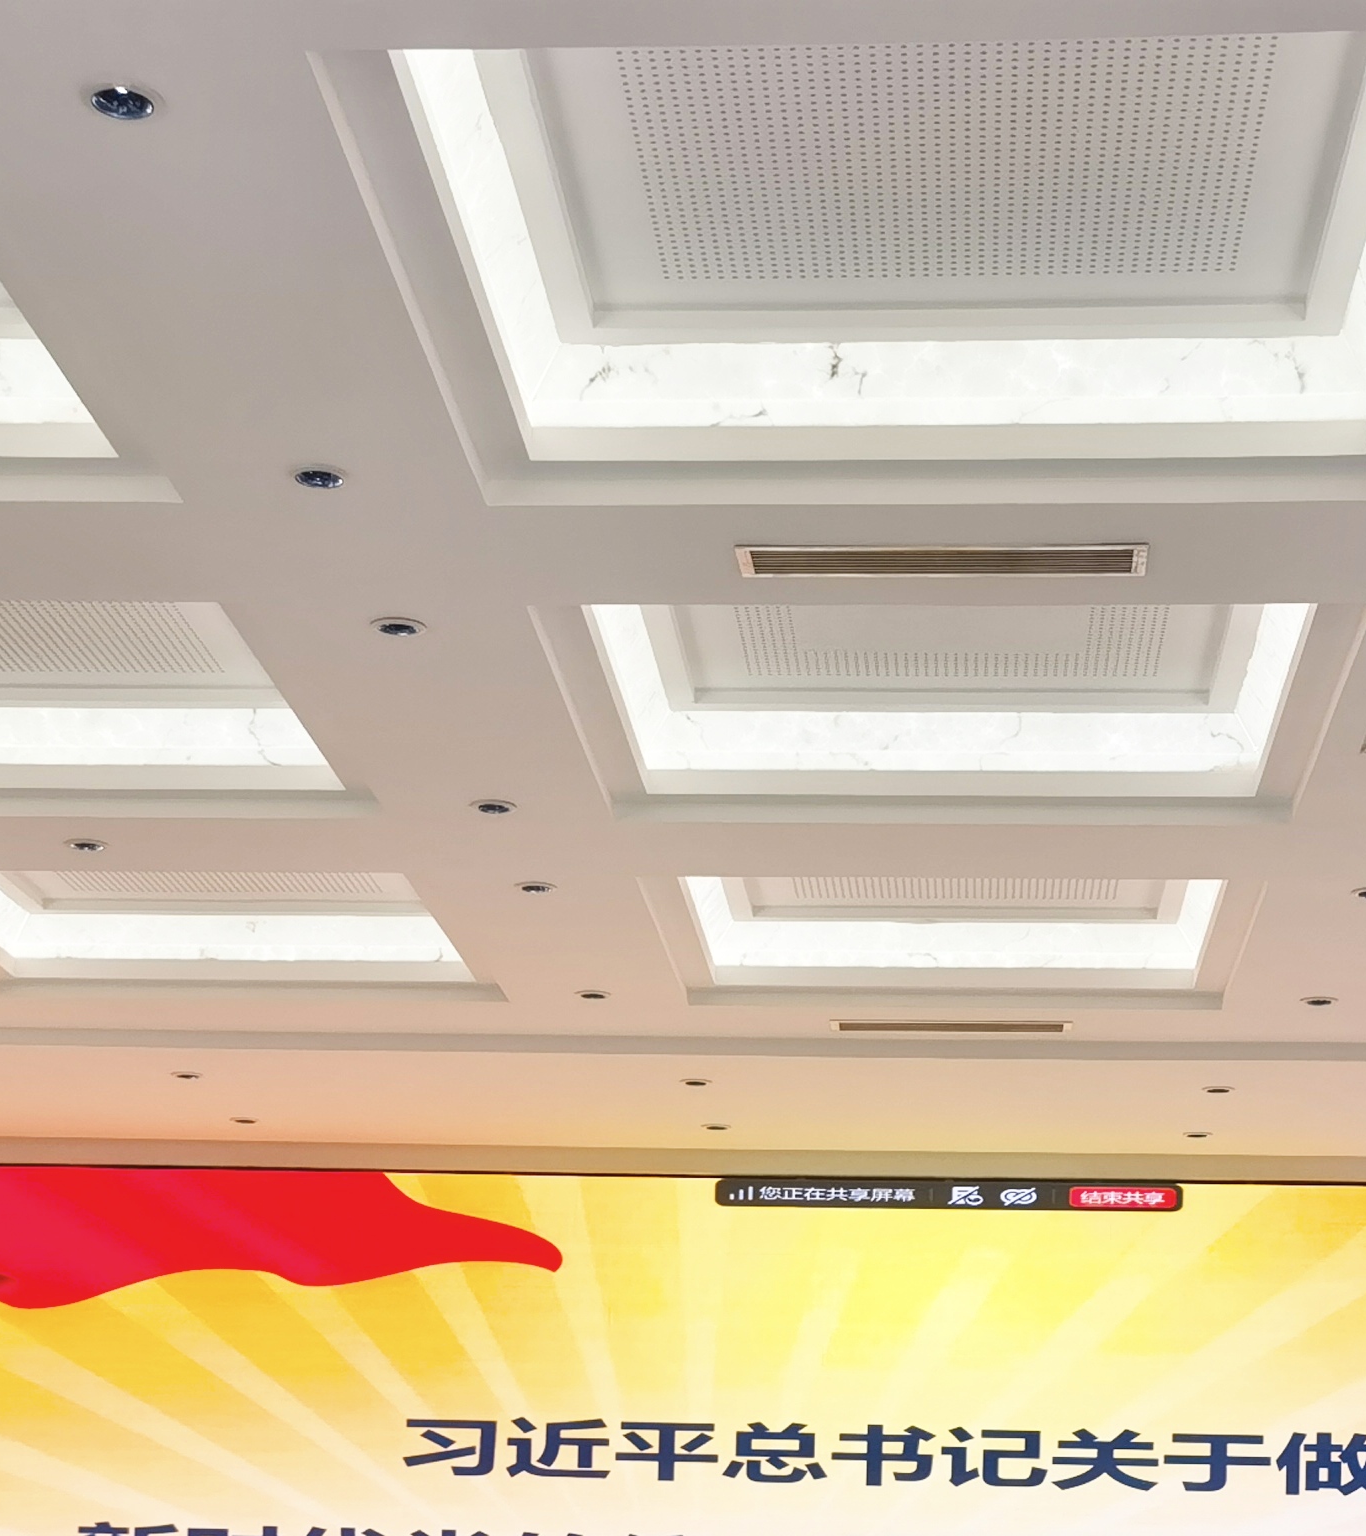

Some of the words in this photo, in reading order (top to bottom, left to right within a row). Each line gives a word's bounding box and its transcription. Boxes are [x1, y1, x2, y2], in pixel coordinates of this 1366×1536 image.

[759, 1185, 916, 1203] 您正在共享屏幕
[1080, 1187, 1166, 1206] 结束共享
